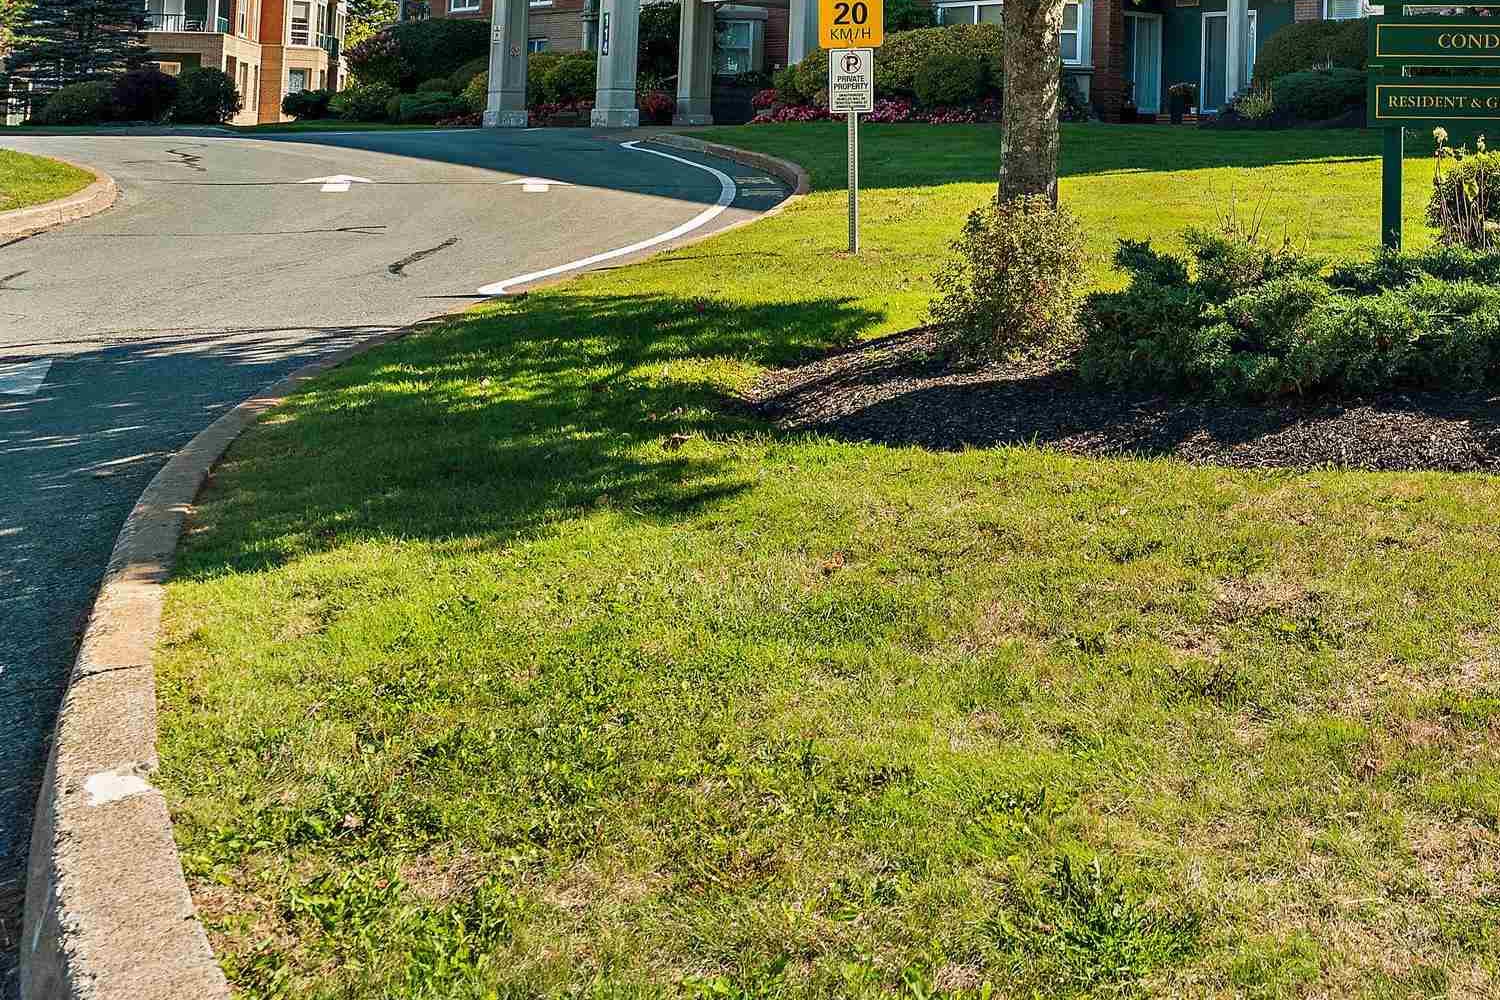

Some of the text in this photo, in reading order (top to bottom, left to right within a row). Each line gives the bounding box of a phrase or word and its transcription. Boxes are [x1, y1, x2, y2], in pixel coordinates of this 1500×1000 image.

[833, 1, 869, 25] 20
[830, 28, 872, 41] KM/H
[837, 74, 865, 82] PRIVATE
[833, 82, 869, 90] PROPERTY
[1388, 94, 1468, 109] RESIDENT
[1471, 97, 1483, 109] &
